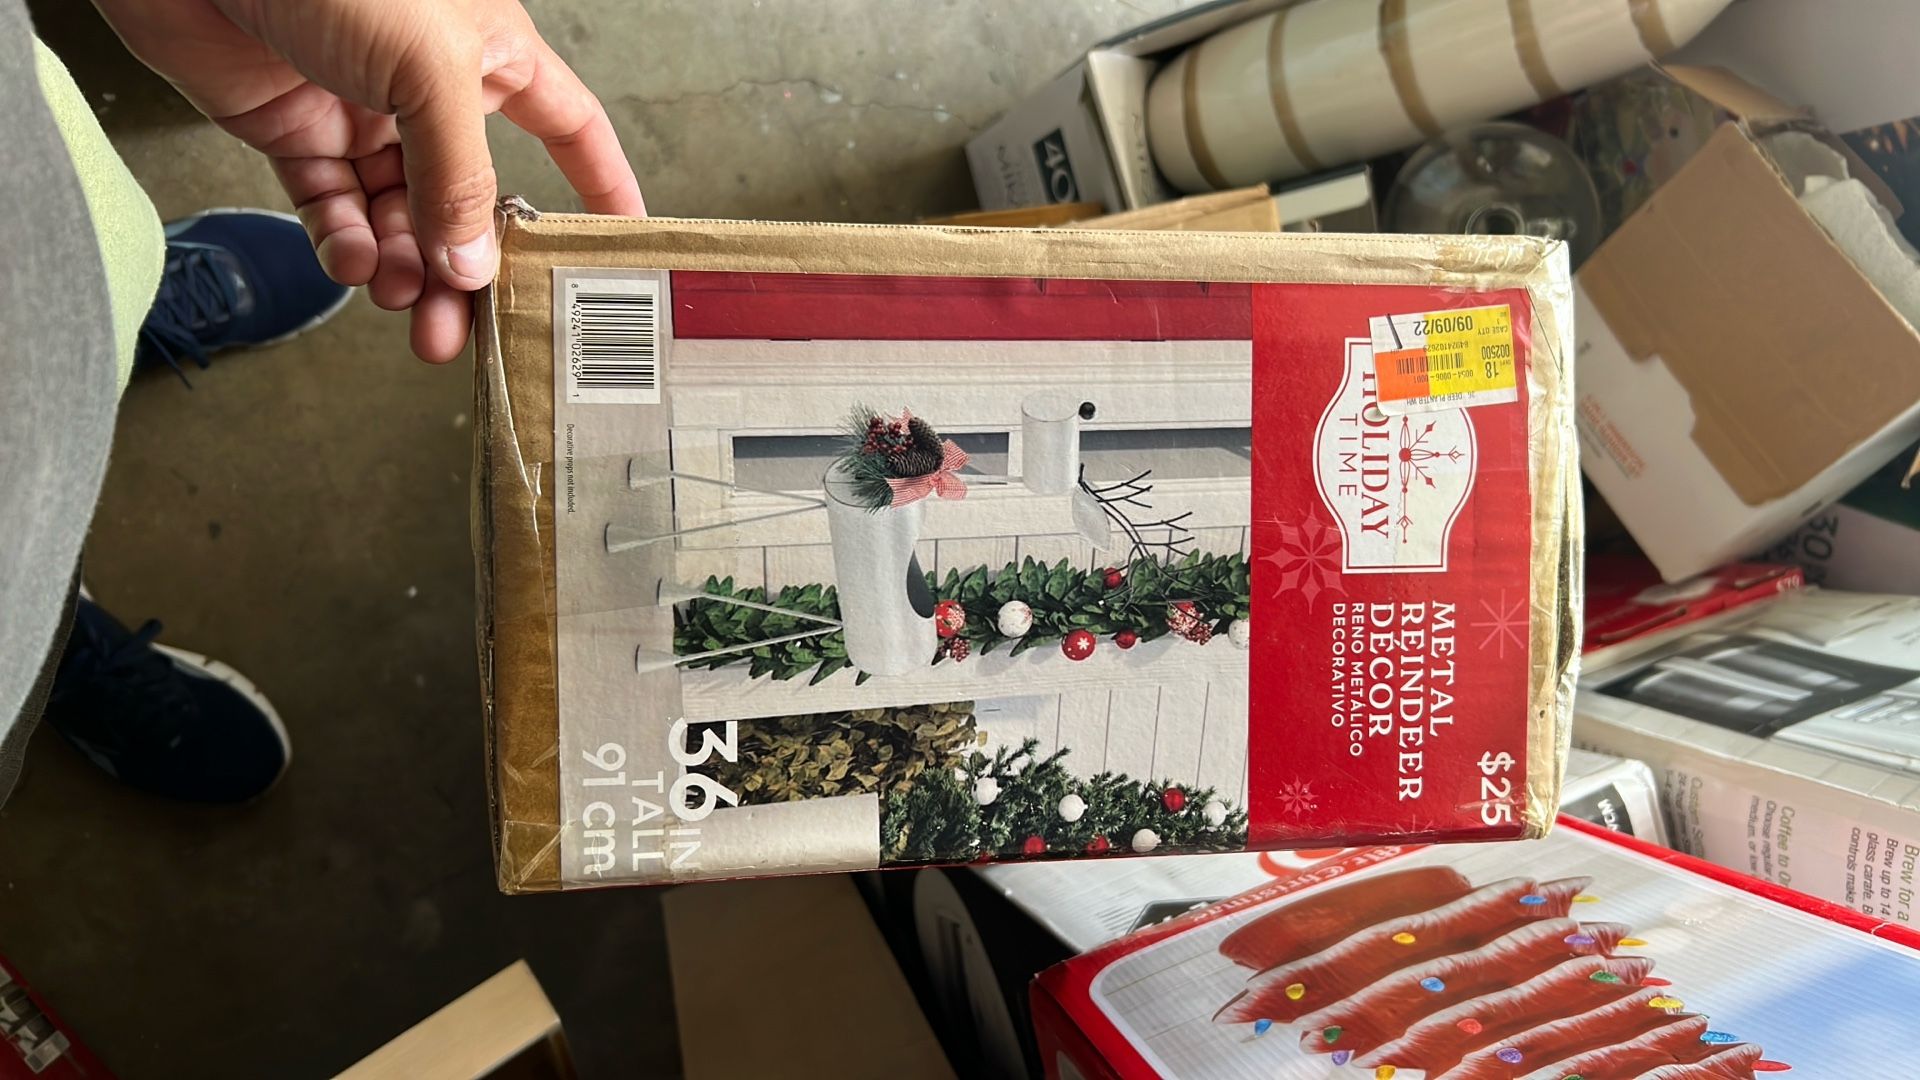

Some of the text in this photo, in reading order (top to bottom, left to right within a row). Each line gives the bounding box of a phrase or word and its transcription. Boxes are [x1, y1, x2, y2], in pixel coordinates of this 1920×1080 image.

[571, 303, 581, 338] 49241
[1414, 315, 1474, 336] 09/09/22
[1478, 325, 1508, 336] CASE QTY
[571, 343, 582, 378] 02629
[1481, 343, 1510, 361] 002500
[1485, 362, 1500, 379] 18
[1419, 394, 1446, 405] PLANTER
[1447, 392, 1463, 403] DEER
[566, 423, 575, 456] Decorative
[1338, 413, 1358, 497] TIME
[564, 456, 574, 474] props
[567, 474, 575, 485] not
[1331, 603, 1346, 727] DECORATIVO
[1350, 603, 1367, 756] RENO METÁLICO
[1368, 602, 1401, 738] DÉCOR
[1430, 600, 1456, 737] METAL
[1398, 601, 1425, 801] REINDEER
[582, 742, 627, 875] 91 cm
[668, 717, 738, 873] 36 IN
[1477, 751, 1516, 826] $25
[631, 771, 665, 872] TALL
[1761, 800, 1776, 839] Choose
[1777, 805, 1795, 852] Coffee
[1777, 853, 1790, 868] to
[1845, 826, 1861, 904] controls make
[1865, 831, 1879, 863] glass
[1191, 864, 1346, 923] Christmas
[1863, 863, 1875, 900] carafe.
[1880, 837, 1899, 917] Brew up to 14
[1896, 843, 1920, 922] Brew for a
